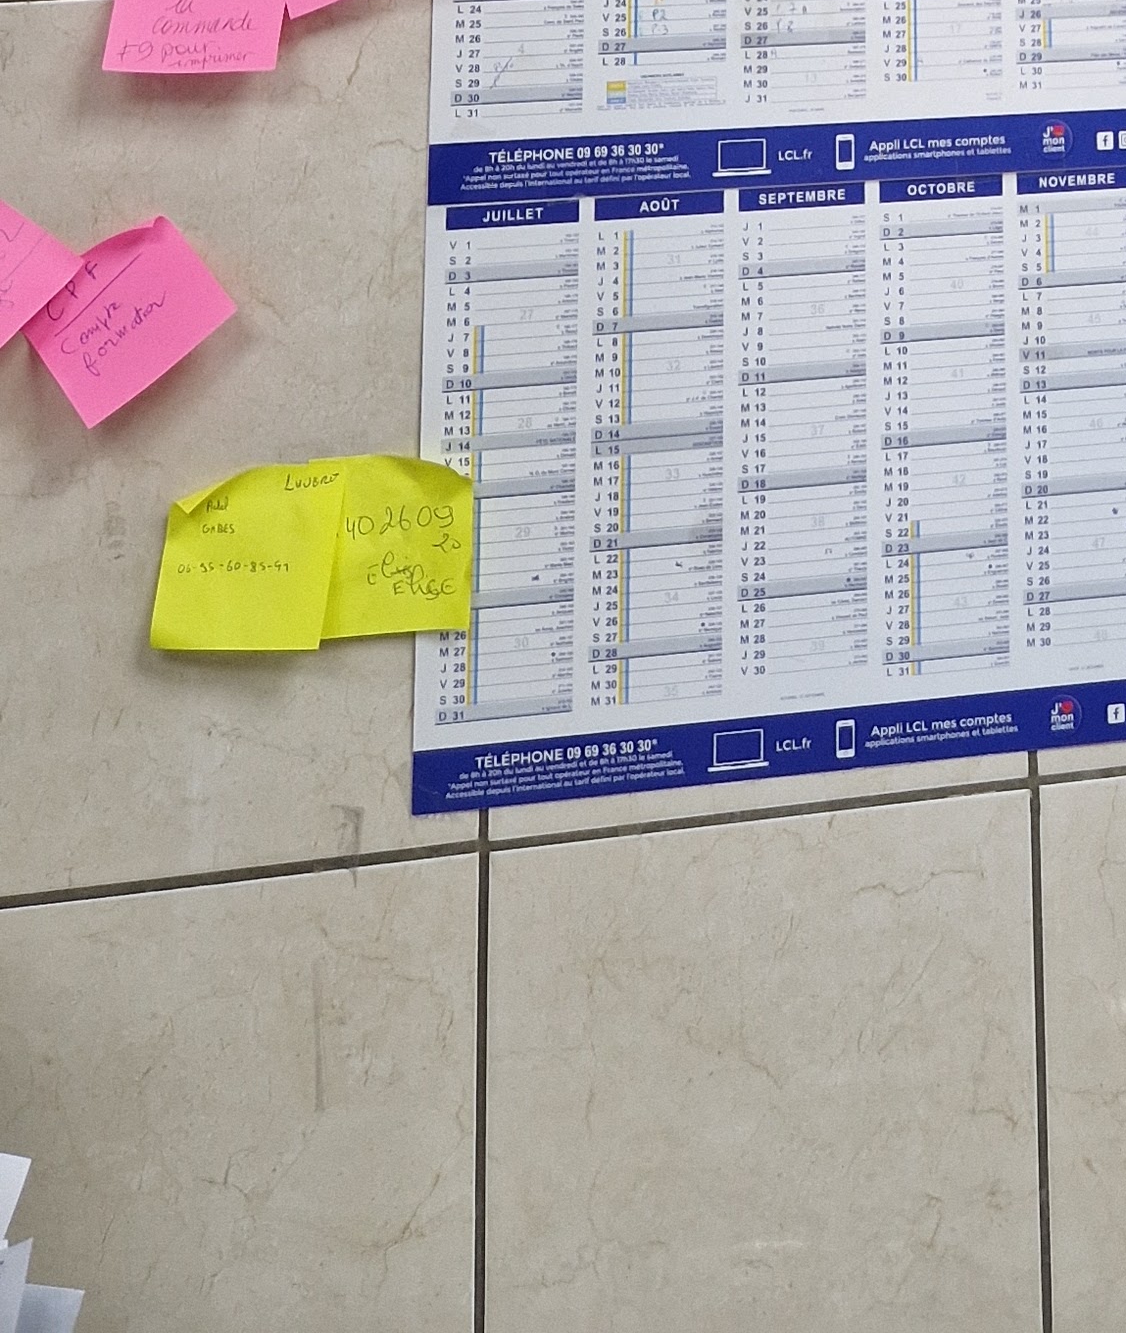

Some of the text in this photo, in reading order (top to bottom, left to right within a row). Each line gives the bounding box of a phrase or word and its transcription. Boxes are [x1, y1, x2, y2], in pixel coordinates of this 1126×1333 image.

[869, 134, 1005, 152] Appli LCL mes comptes
[488, 145, 575, 163] TÉLÉPHONE
[577, 145, 591, 158] 09
[594, 145, 608, 157] 69
[611, 144, 625, 156] 36
[627, 143, 641, 155] 30
[777, 148, 812, 162] LCL.fr
[483, 207, 544, 222] JUILLET
[639, 199, 679, 213] AOÛT
[759, 189, 846, 205] SEPTEMBRE
[908, 181, 975, 196] OCTOBRE
[1038, 172, 1115, 188] NOVEMBRE
